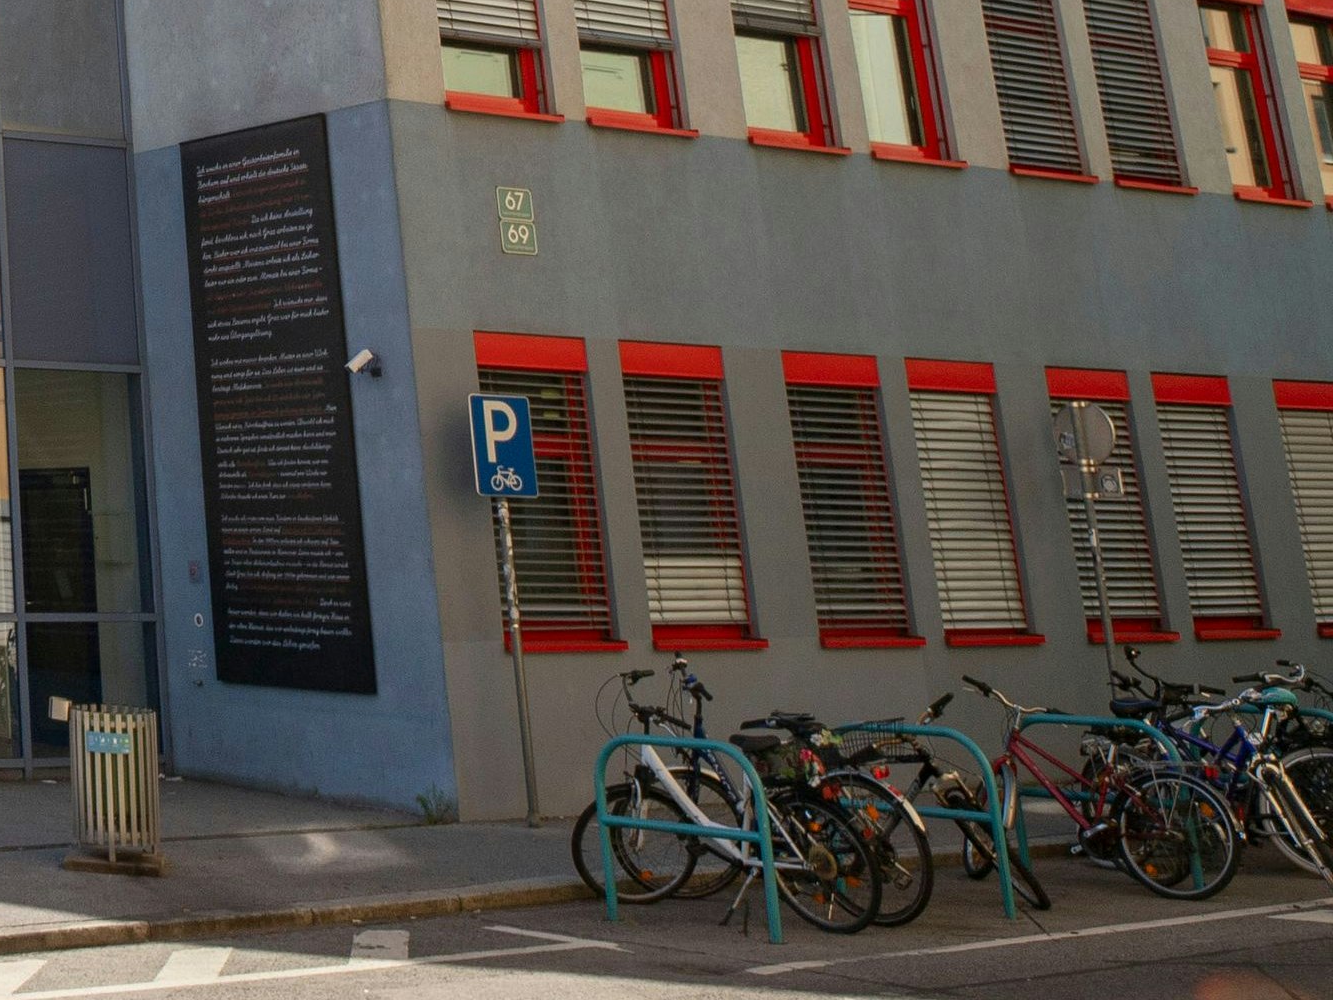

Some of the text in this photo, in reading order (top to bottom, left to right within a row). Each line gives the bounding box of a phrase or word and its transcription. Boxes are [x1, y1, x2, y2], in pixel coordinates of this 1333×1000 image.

[505, 191, 524, 211] 67
[508, 224, 530, 245] 69
[484, 400, 518, 464] P
